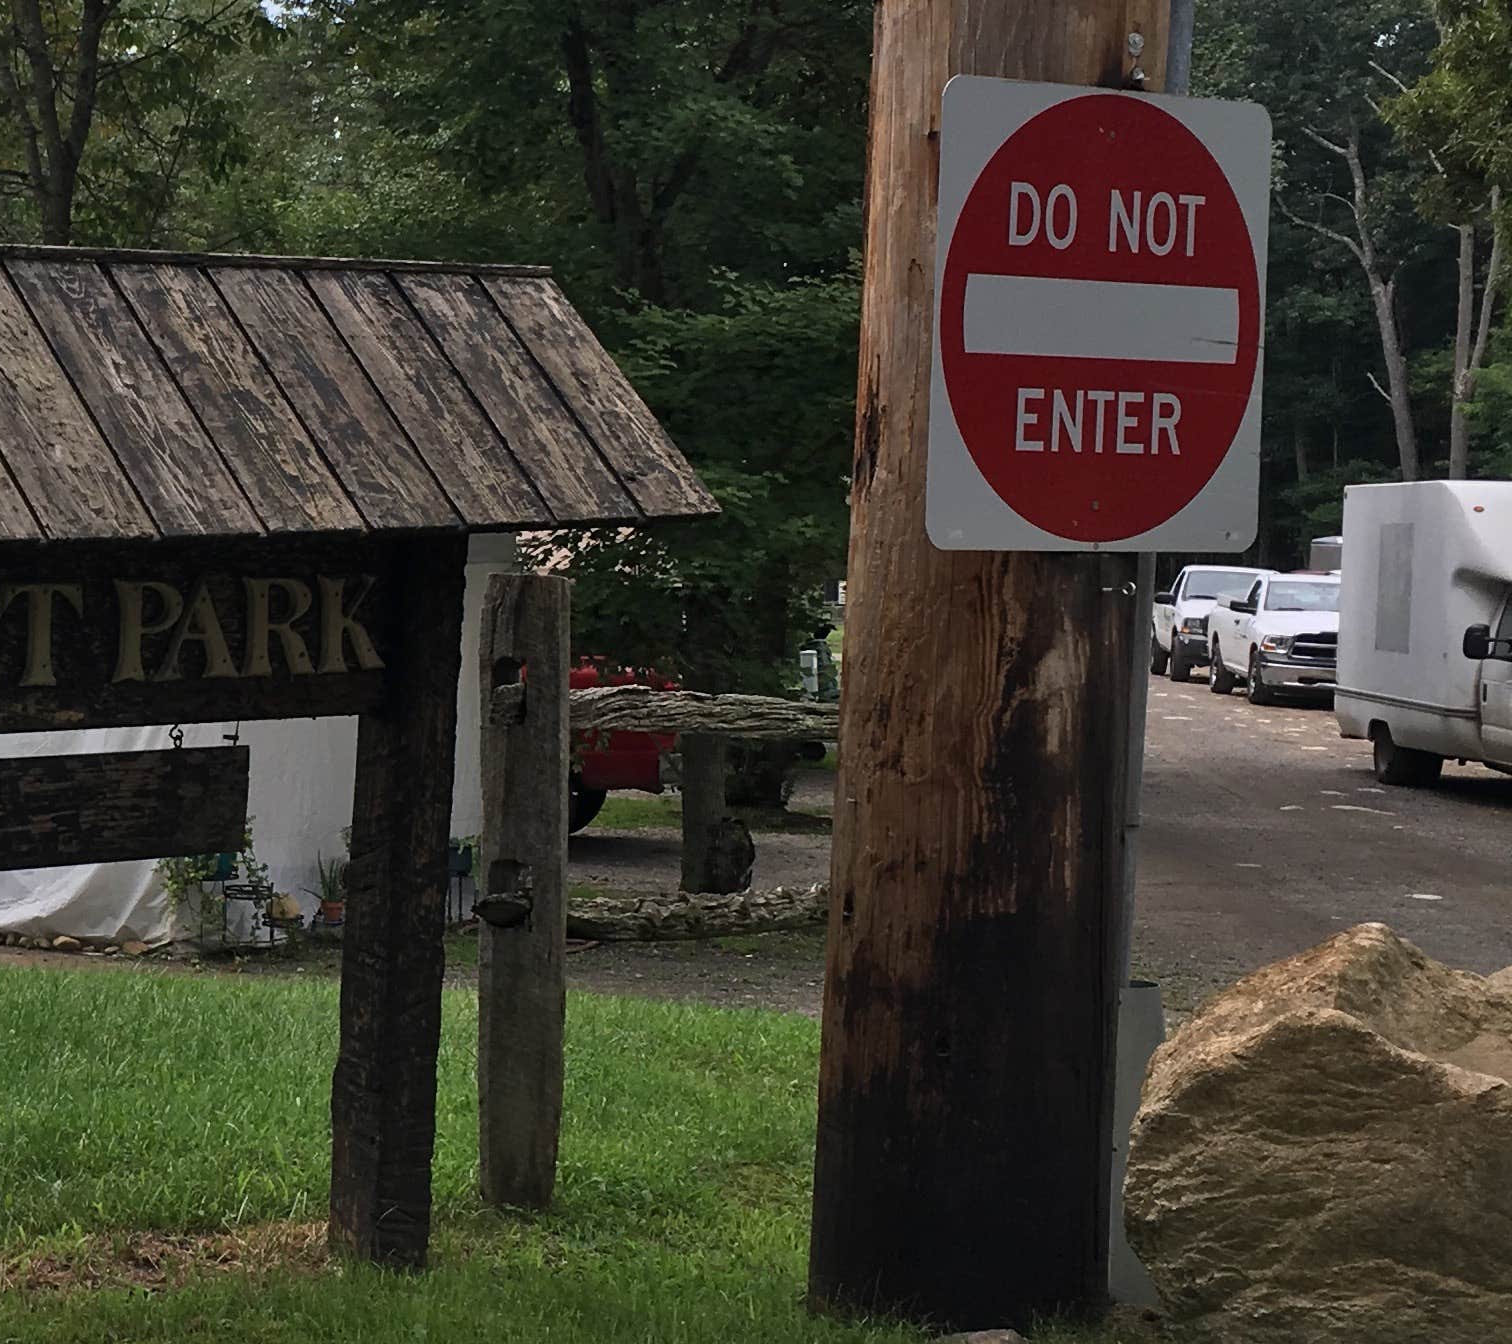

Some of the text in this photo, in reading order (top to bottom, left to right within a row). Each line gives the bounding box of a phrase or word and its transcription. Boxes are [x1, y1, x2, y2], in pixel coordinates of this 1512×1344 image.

[1007, 180, 1207, 257] DO NOT
[1014, 386, 1183, 456] ENTER
[112, 572, 387, 684] PARK
